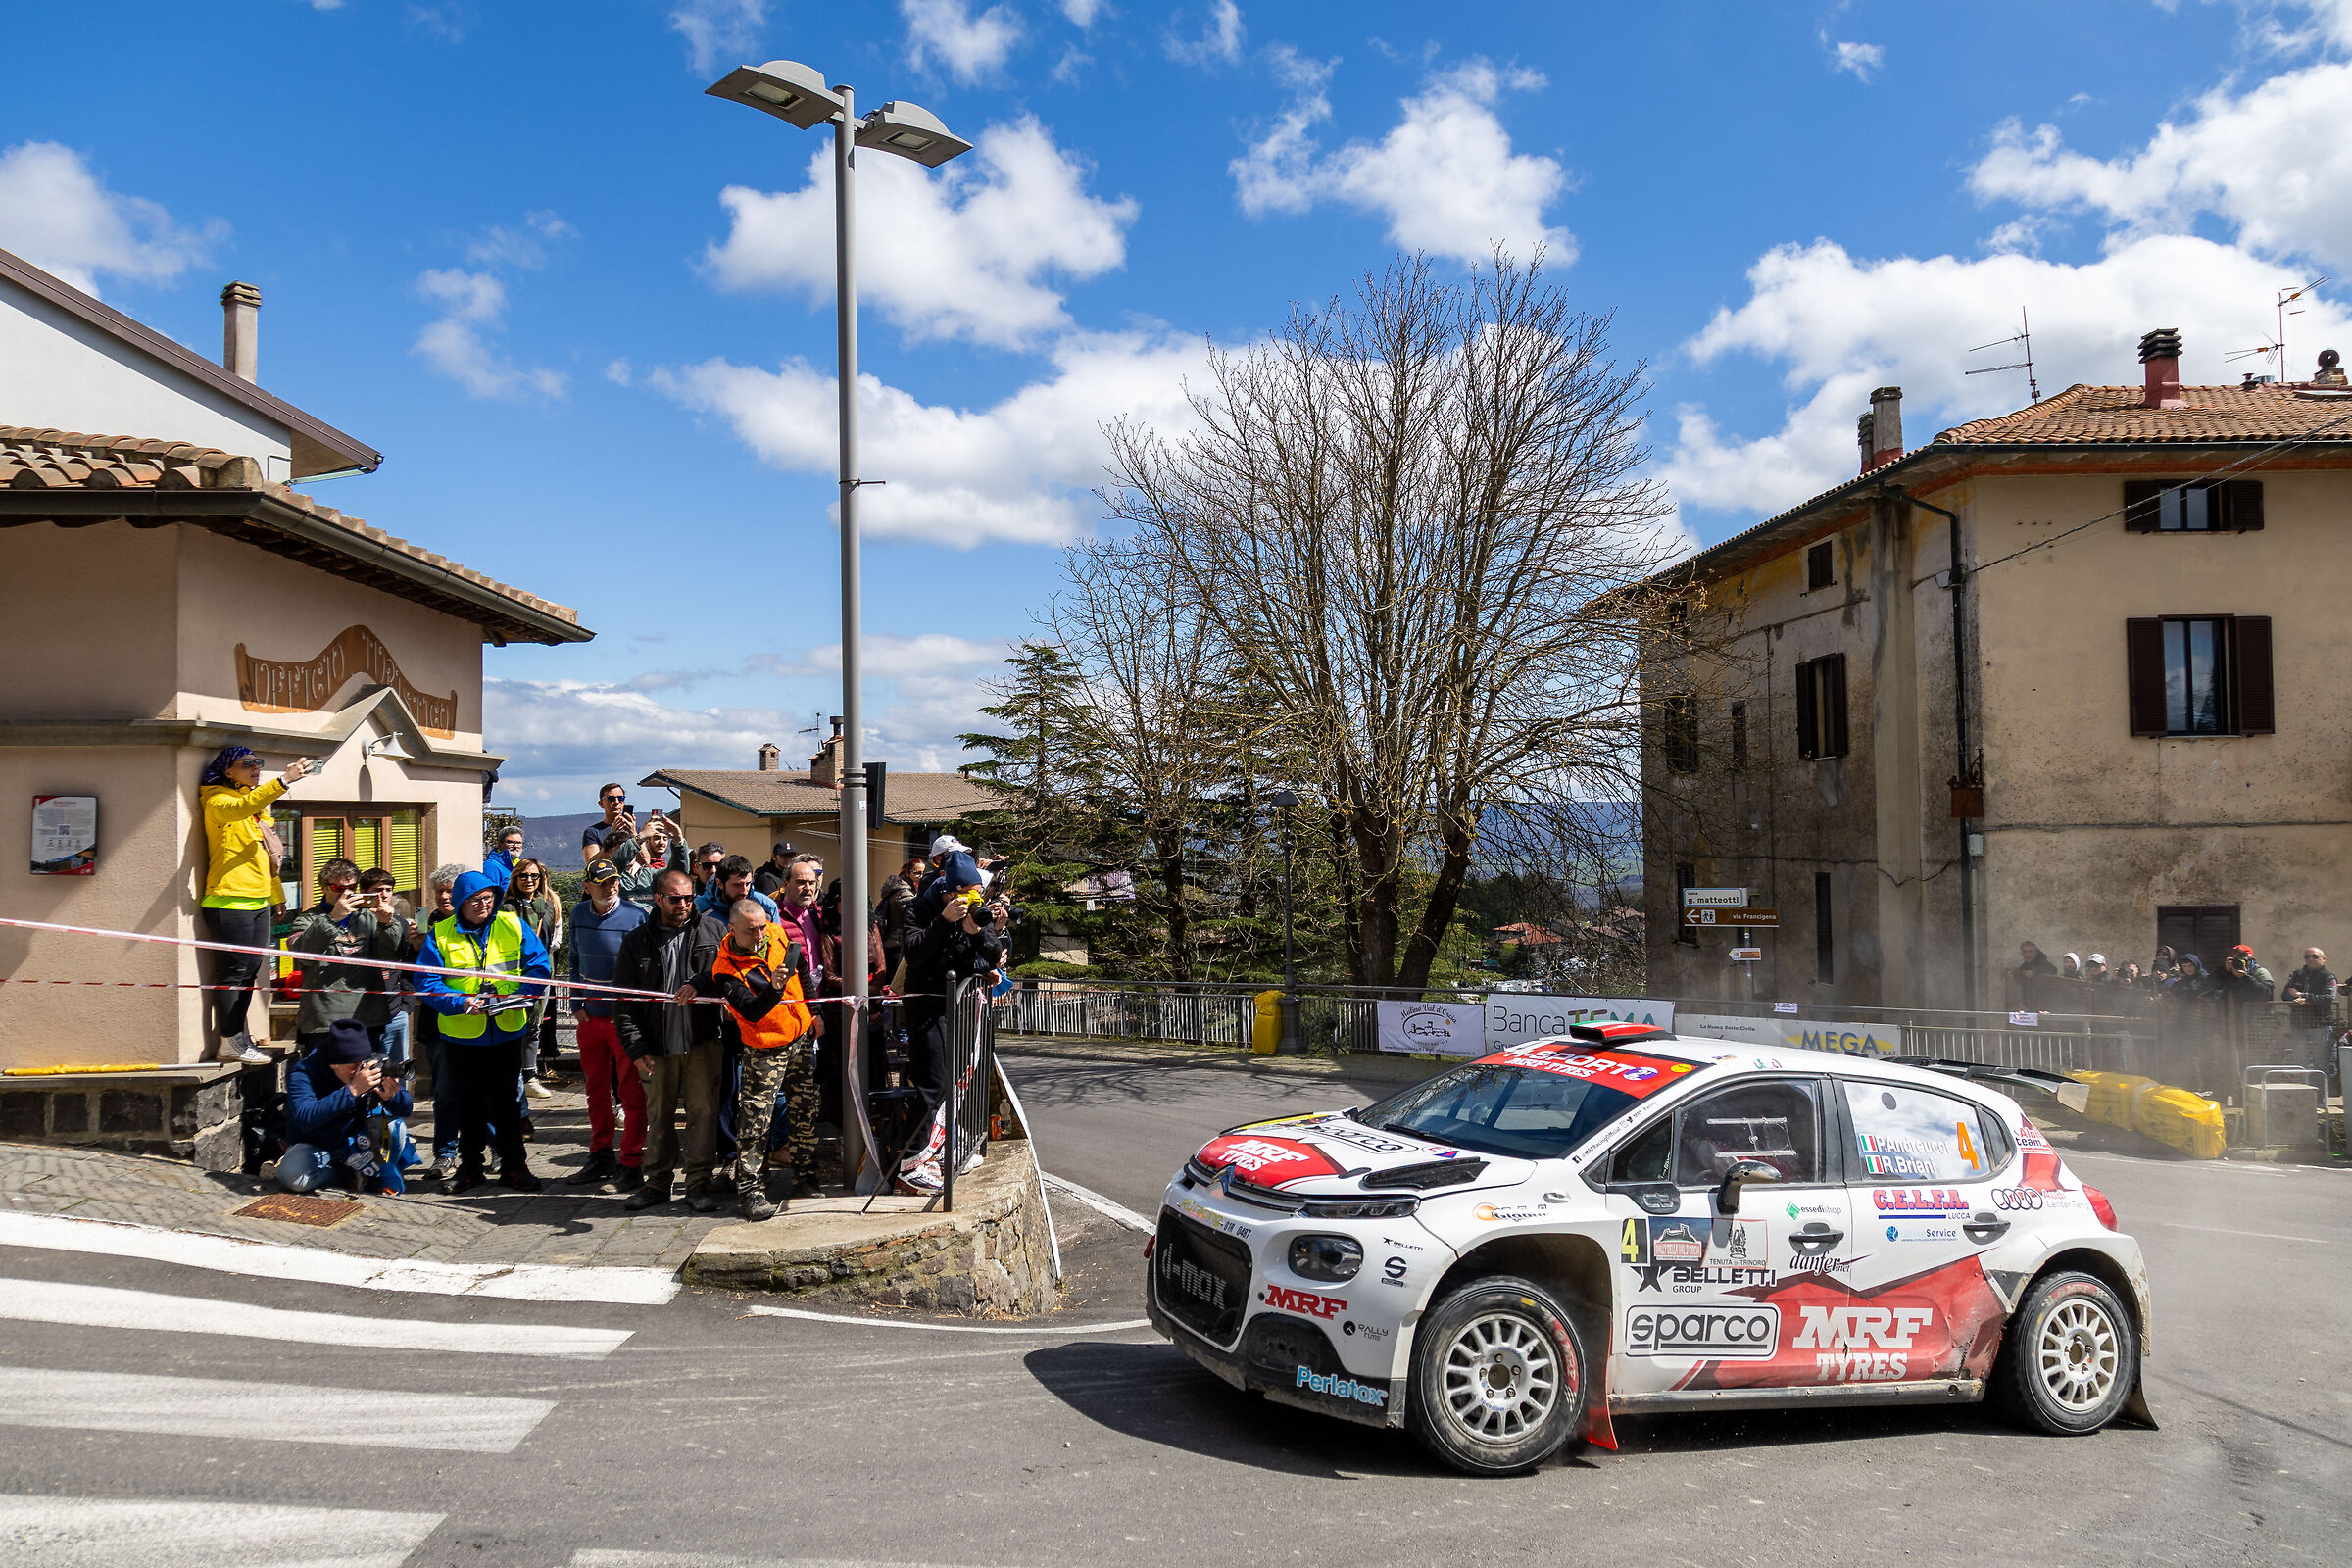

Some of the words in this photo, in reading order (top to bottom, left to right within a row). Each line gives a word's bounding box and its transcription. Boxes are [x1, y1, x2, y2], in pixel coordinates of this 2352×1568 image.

[1801, 1028, 1880, 1054] MEGA
[1505, 1057, 1550, 1070] MRF
[1544, 1062, 1597, 1078] TYRES
[1227, 1139, 1310, 1162] MRF
[1876, 1135, 1950, 1155] P.Andreucci
[1956, 1121, 1981, 1171] 4
[2015, 1137, 2042, 1147] team
[1218, 1150, 1270, 1172] TYRES
[1883, 1154, 1937, 1175] R.Briani
[1800, 1204, 1842, 1215] essedishop
[1873, 1189, 1970, 1211] C.E.L.F.A.
[1621, 1218, 1639, 1263] 4
[1926, 1228, 1957, 1238] Service
[1672, 1266, 1777, 1286] BELLETTI
[1672, 1285, 1702, 1294] GROUP
[1265, 1284, 1348, 1321] MRF
[1358, 1324, 1389, 1337] RALLY
[1630, 1313, 1771, 1351] sparco
[1792, 1306, 1934, 1348] MRF
[1816, 1352, 1908, 1382] TYRES
[1297, 1365, 1389, 1407] Perlatox
